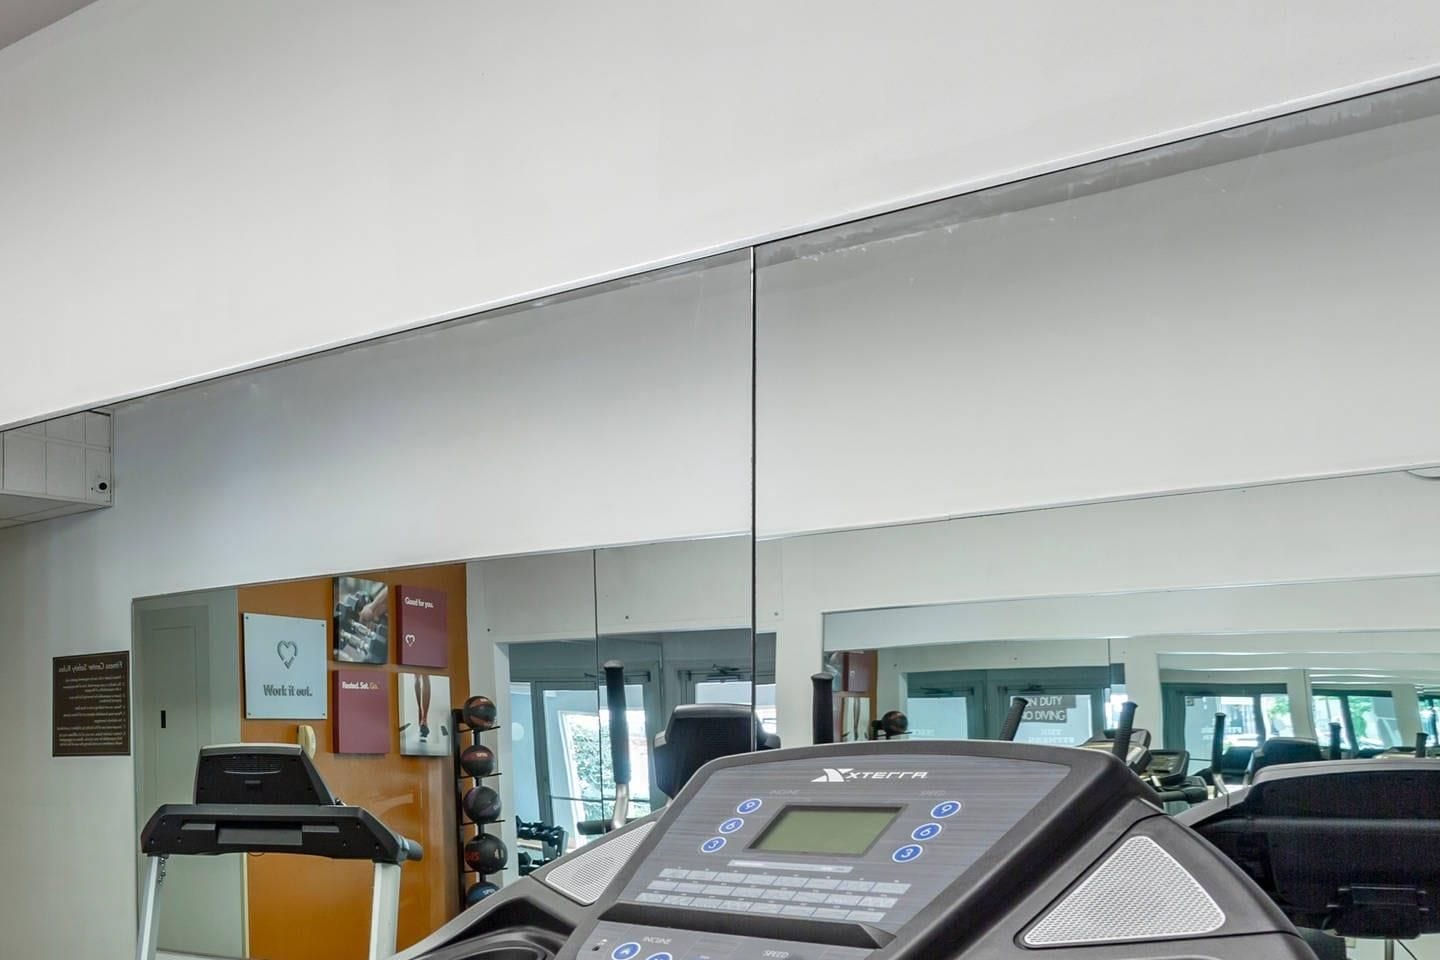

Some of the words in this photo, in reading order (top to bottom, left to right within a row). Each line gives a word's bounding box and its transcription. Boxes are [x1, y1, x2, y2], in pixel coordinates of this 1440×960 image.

[263, 684, 287, 697] Work
[288, 685, 296, 697] it
[296, 686, 313, 697] out.
[1040, 696, 1062, 706] DUTY
[1035, 710, 1065, 721] DIVING
[846, 770, 928, 779] XTERRA
[745, 801, 756, 810] 9
[942, 804, 953, 814] 9
[725, 821, 737, 830] 6
[920, 827, 932, 837] 6
[708, 840, 719, 849] 3
[901, 848, 914, 860] 3
[762, 949, 790, 958] SPEED
